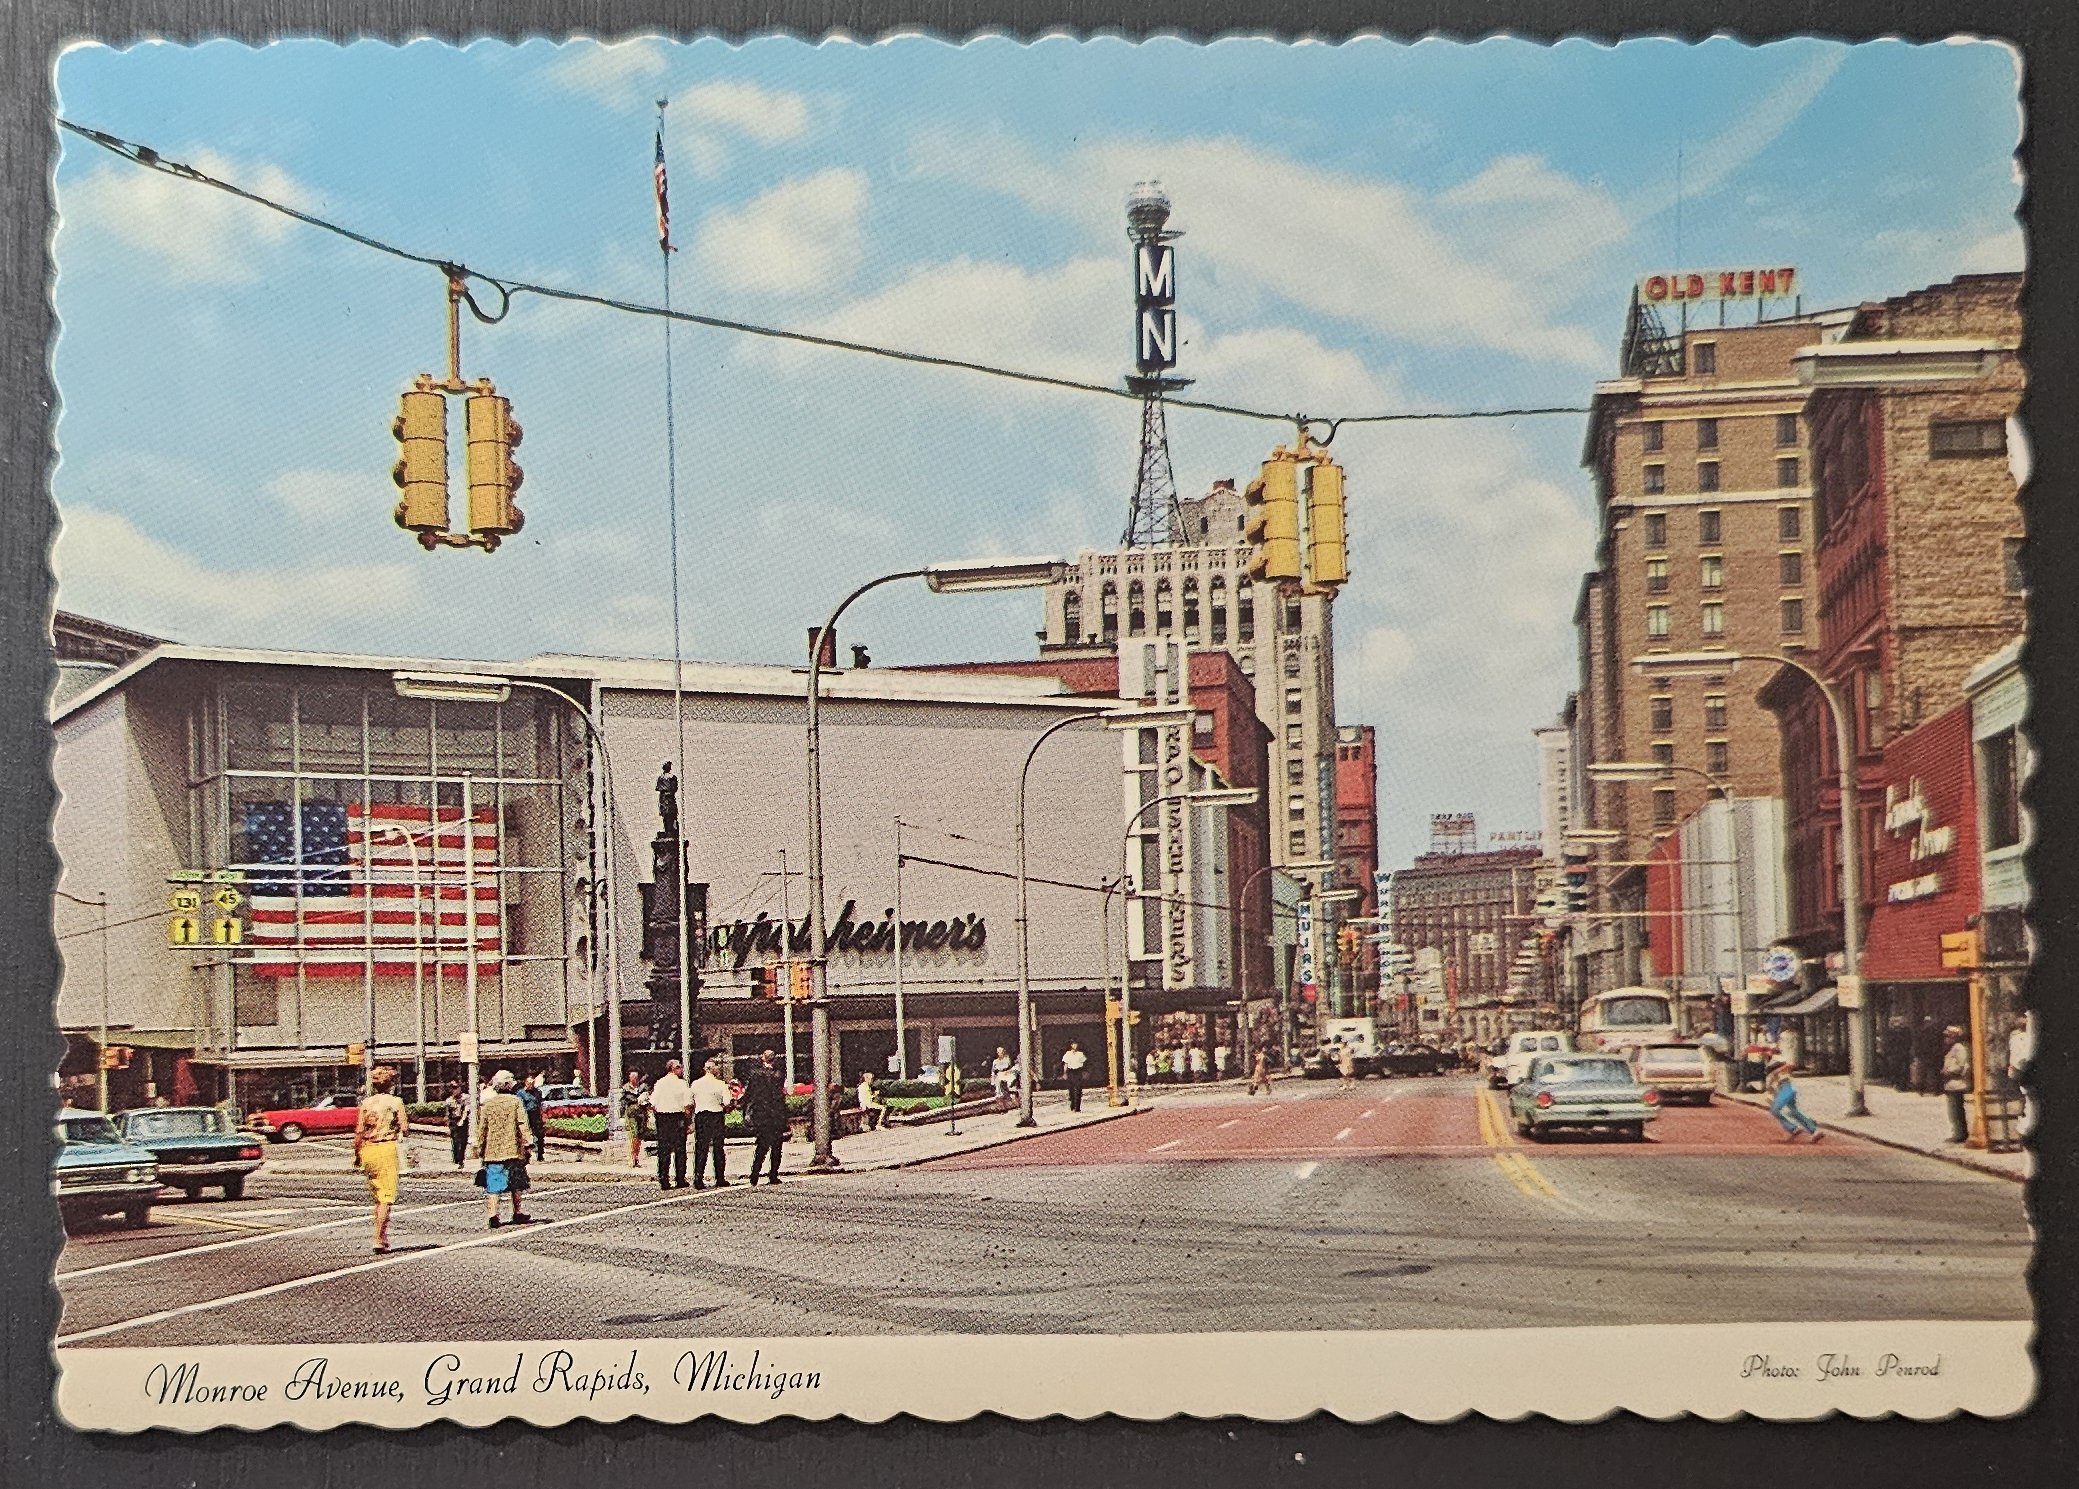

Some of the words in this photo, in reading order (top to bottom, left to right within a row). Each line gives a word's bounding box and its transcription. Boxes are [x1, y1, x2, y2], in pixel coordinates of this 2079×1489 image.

[1645, 273, 1705, 301] OLD
[1719, 268, 1795, 298] KENT
[176, 896, 197, 910] 131
[219, 893, 237, 905] 45
[144, 1362, 269, 1406] Monroe
[284, 1357, 406, 1404] Avenue,
[423, 1352, 524, 1407] Grand
[532, 1349, 651, 1401] Rapids,
[673, 1349, 822, 1400] Michigan
[1740, 1353, 1800, 1378] Photo:
[1815, 1353, 1862, 1382] John
[1874, 1352, 1942, 1377] Penrod
